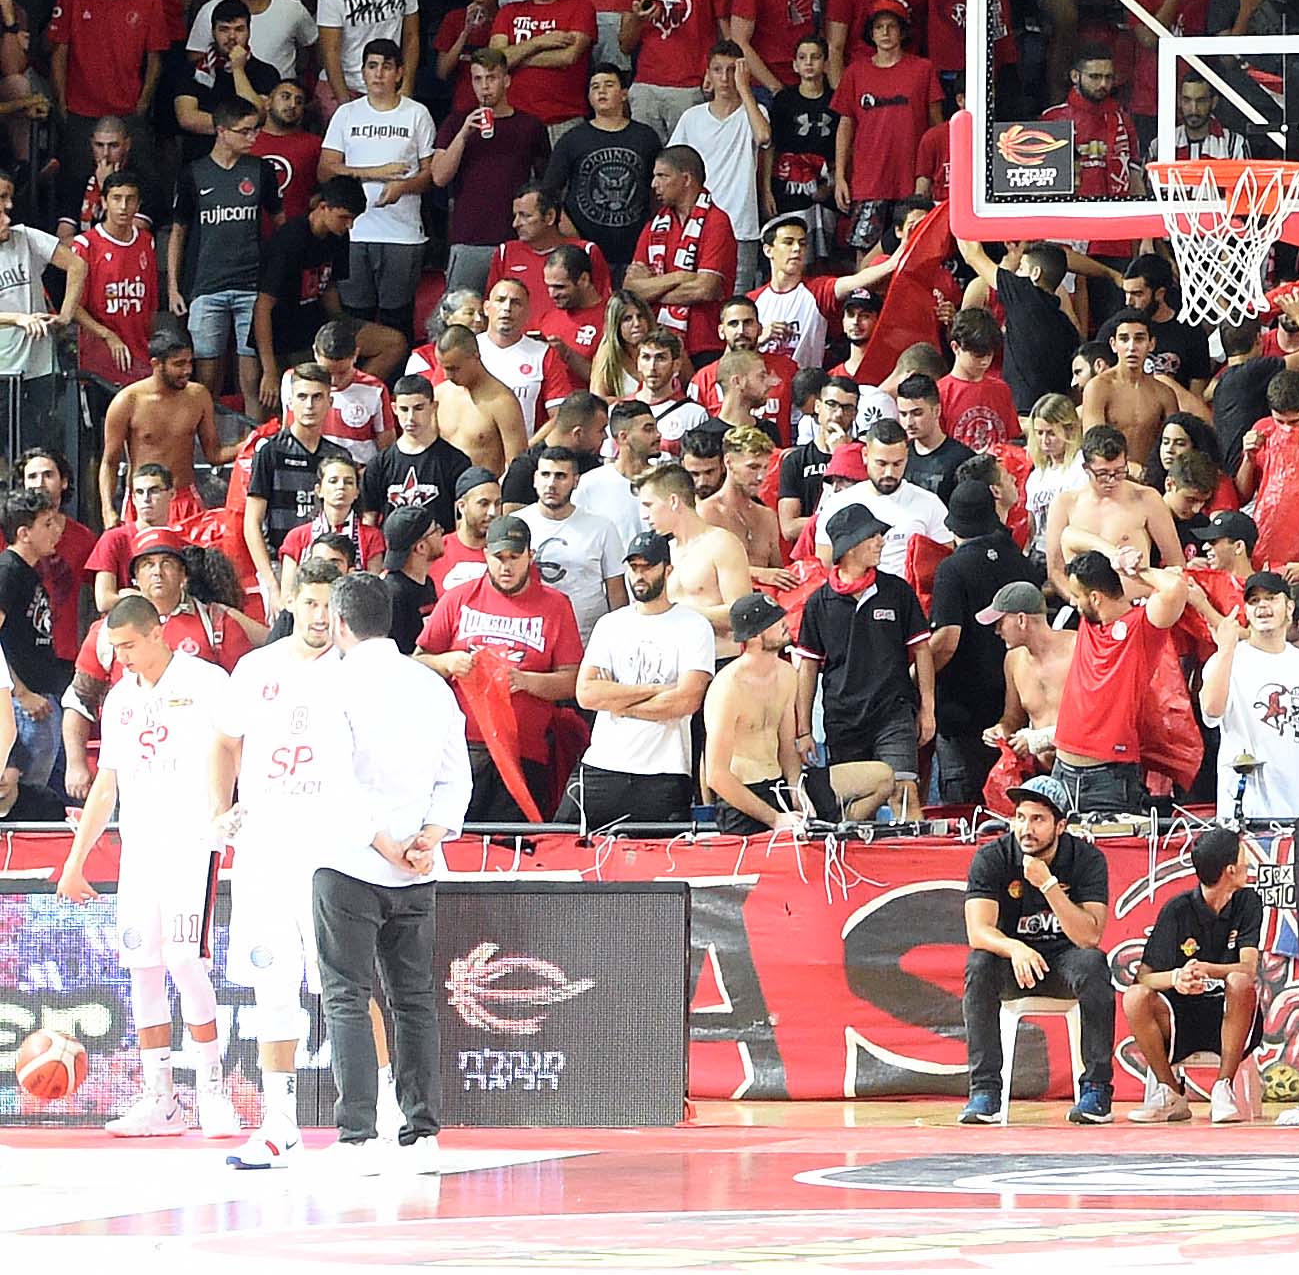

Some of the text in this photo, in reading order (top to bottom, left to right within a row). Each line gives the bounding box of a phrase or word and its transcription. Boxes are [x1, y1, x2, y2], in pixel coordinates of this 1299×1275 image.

[266, 746, 312, 779] SP
[171, 913, 201, 943] 11
[1017, 908, 1064, 934] LOVE
